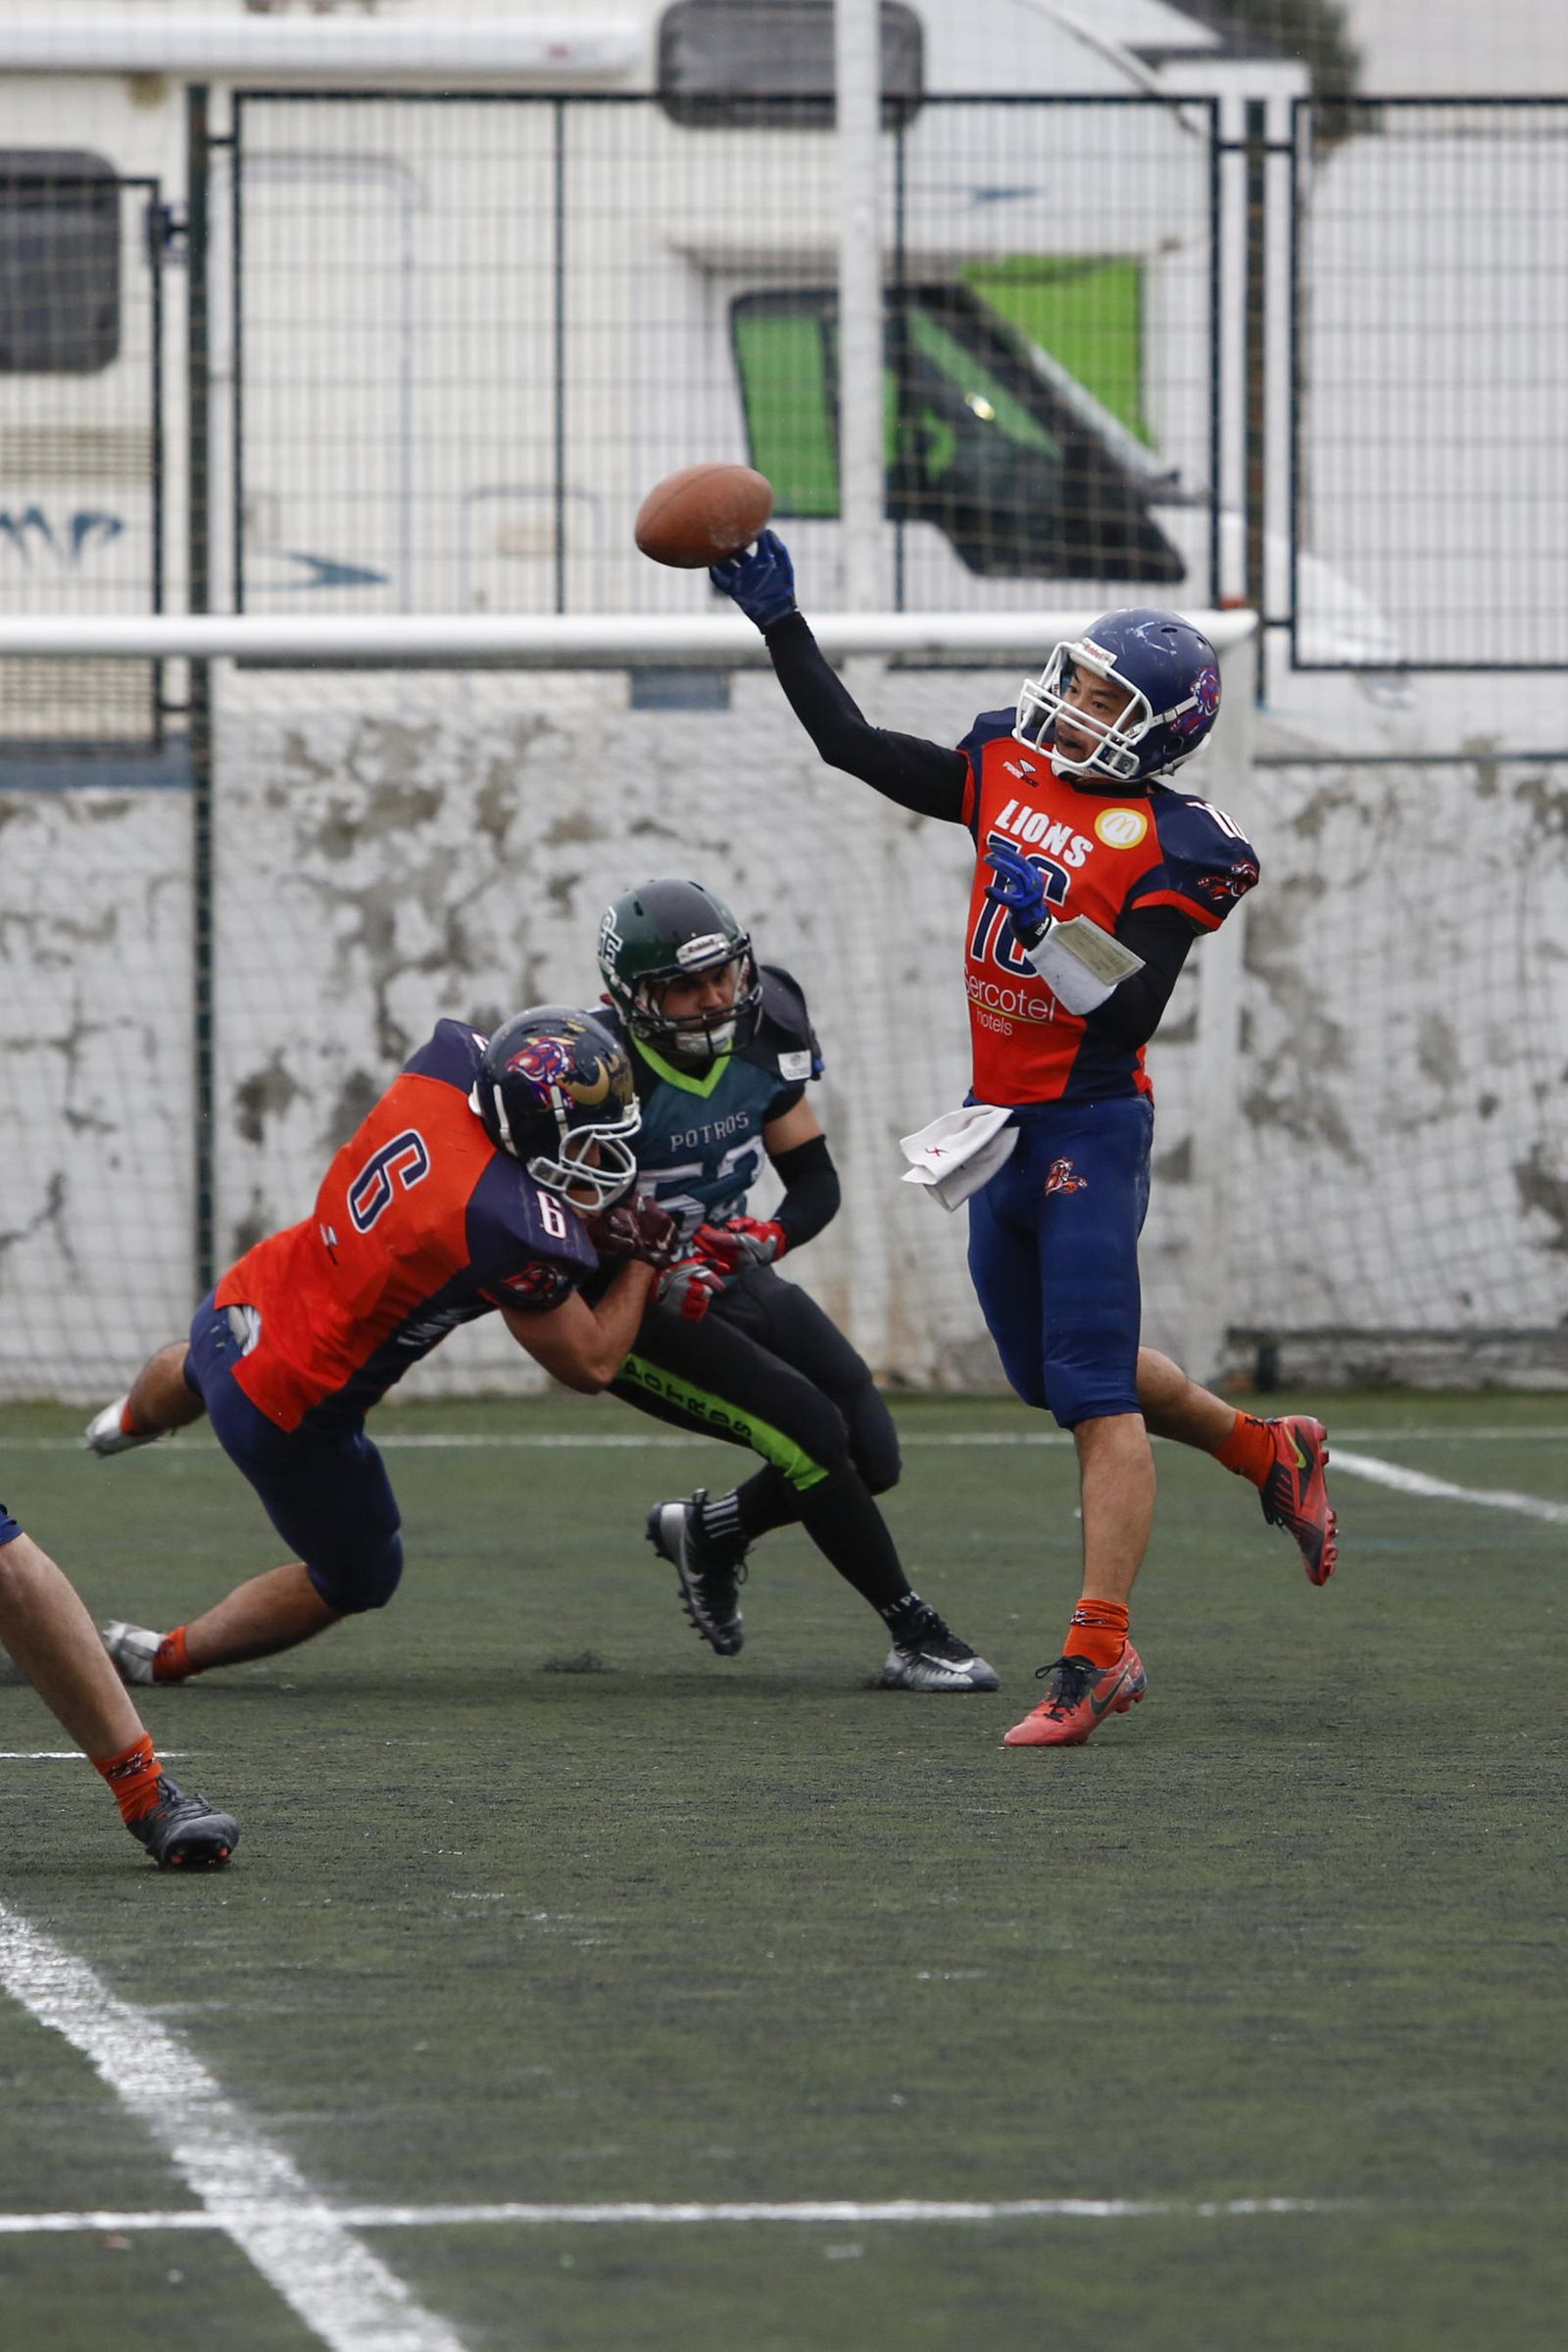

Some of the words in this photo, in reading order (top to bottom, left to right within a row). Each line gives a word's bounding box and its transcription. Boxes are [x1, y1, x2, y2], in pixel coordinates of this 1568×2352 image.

[995, 799, 1094, 867] LIONS
[976, 1006, 1012, 1036] hotels
[670, 1111, 749, 1152] POTROS
[347, 1129, 430, 1234] 6
[536, 1191, 566, 1239] 6
[623, 1356, 753, 1438] POTROS
